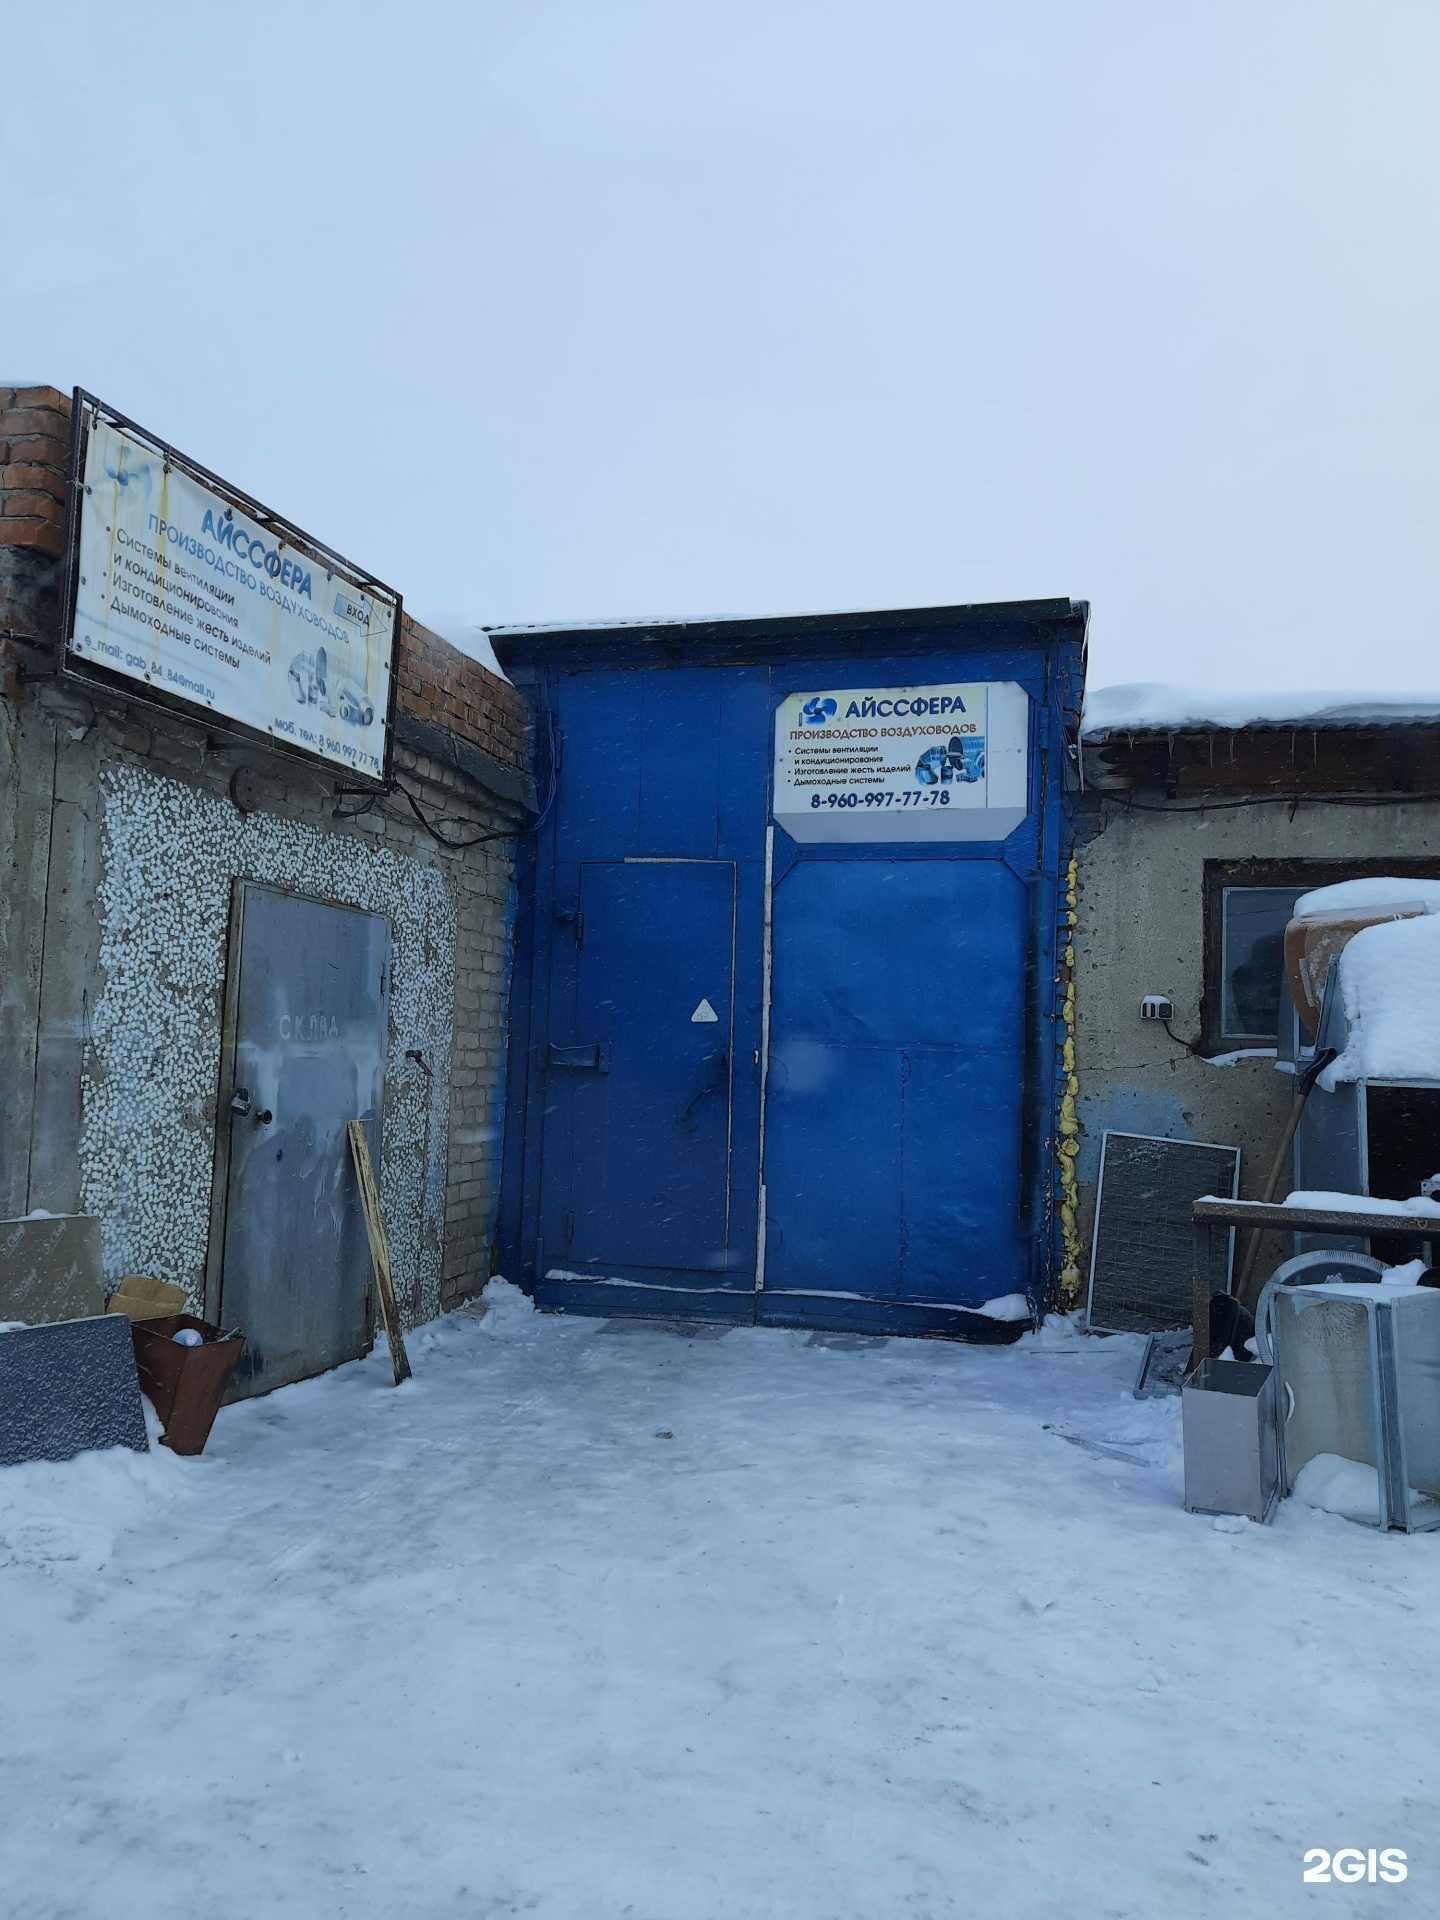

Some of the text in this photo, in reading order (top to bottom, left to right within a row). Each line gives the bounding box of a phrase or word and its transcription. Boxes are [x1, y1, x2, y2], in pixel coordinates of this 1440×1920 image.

[117, 527, 235, 606] Системы вентиляции
[201, 508, 312, 601] АЙССФЕРА
[114, 553, 239, 627] и кондиционирования
[148, 513, 350, 644] ПРОИЗВОДСТВО ВОЗДУХОВОДОВ
[113, 573, 271, 665] Изготовление жесть изделий
[346, 603, 370, 628] ВХОД
[110, 595, 240, 670] Дымоходные системы
[845, 695, 966, 718] АЙССФЕРА
[790, 723, 977, 741] ПРОИЗВОДСТВО ВОЗДУХОВОДОВ
[319, 734, 325, 747] 8
[326, 738, 341, 754] 960
[342, 744, 357, 760] 997
[358, 751, 367, 764] 77
[369, 755, 380, 770] 78
[794, 745, 879, 755] Системы вентиляции
[801, 755, 884, 765] кондиционирования
[793, 776, 885, 787] Дымоходные системы
[794, 764, 911, 776] Изготовление жесть изделий
[810, 790, 950, 809] 8-960-997-77-78
